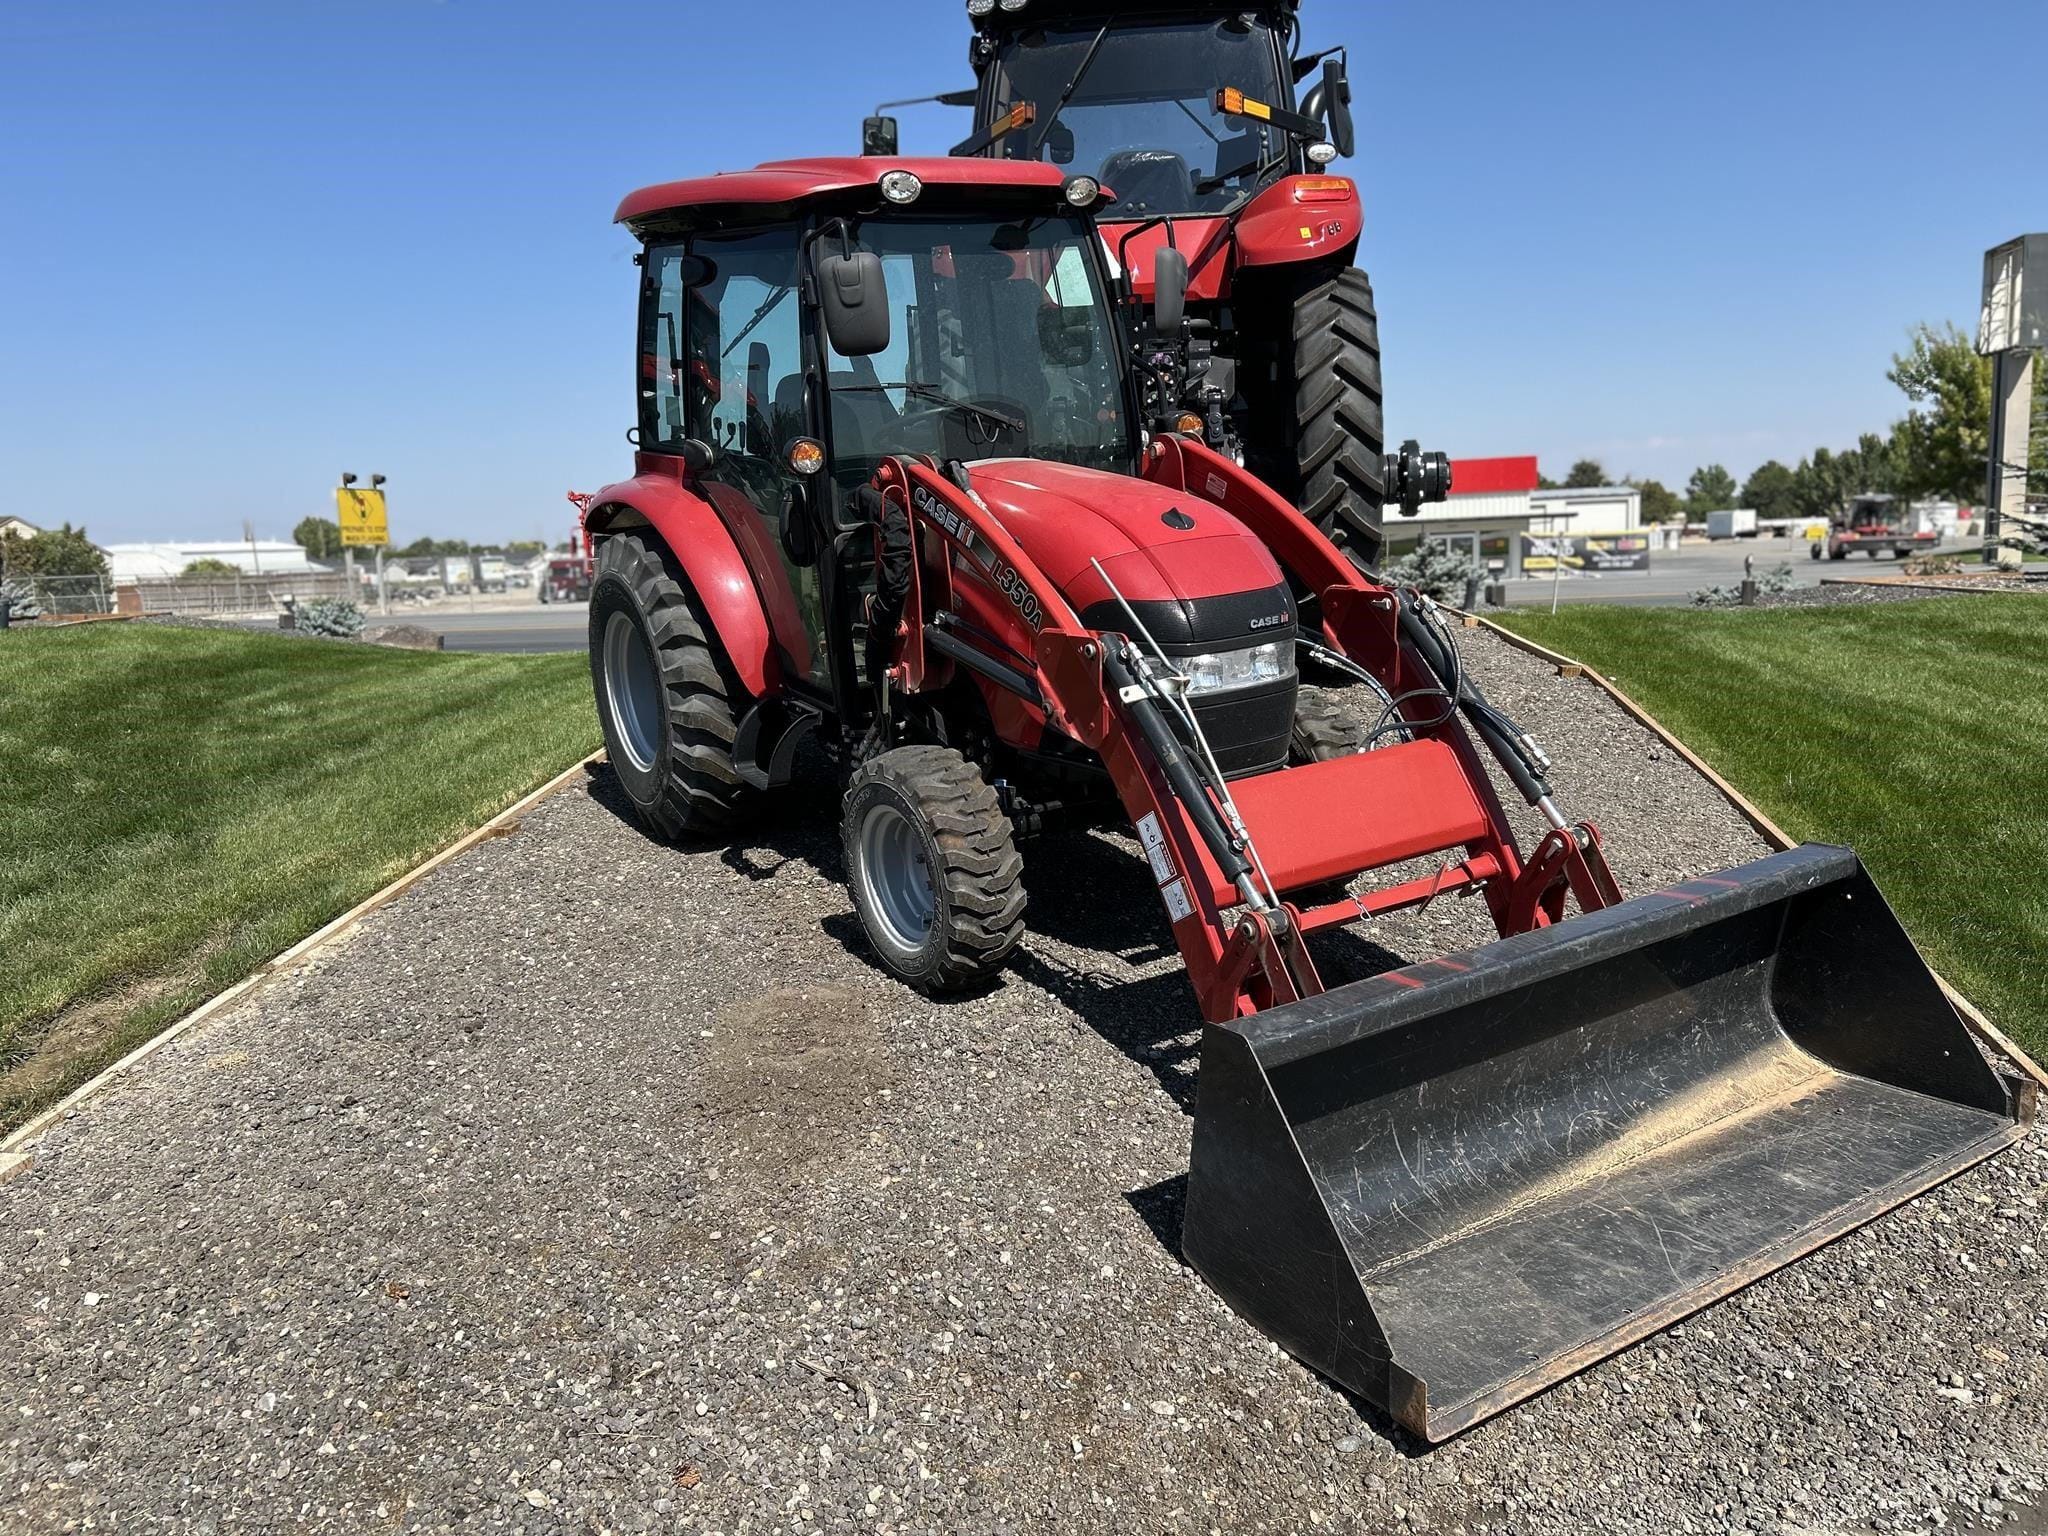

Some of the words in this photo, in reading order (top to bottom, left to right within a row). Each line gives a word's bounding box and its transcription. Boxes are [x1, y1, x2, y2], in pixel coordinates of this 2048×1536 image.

[914, 487, 959, 535] CASE
[991, 559, 1043, 633] L350A
[1250, 615, 1279, 629] CASE
